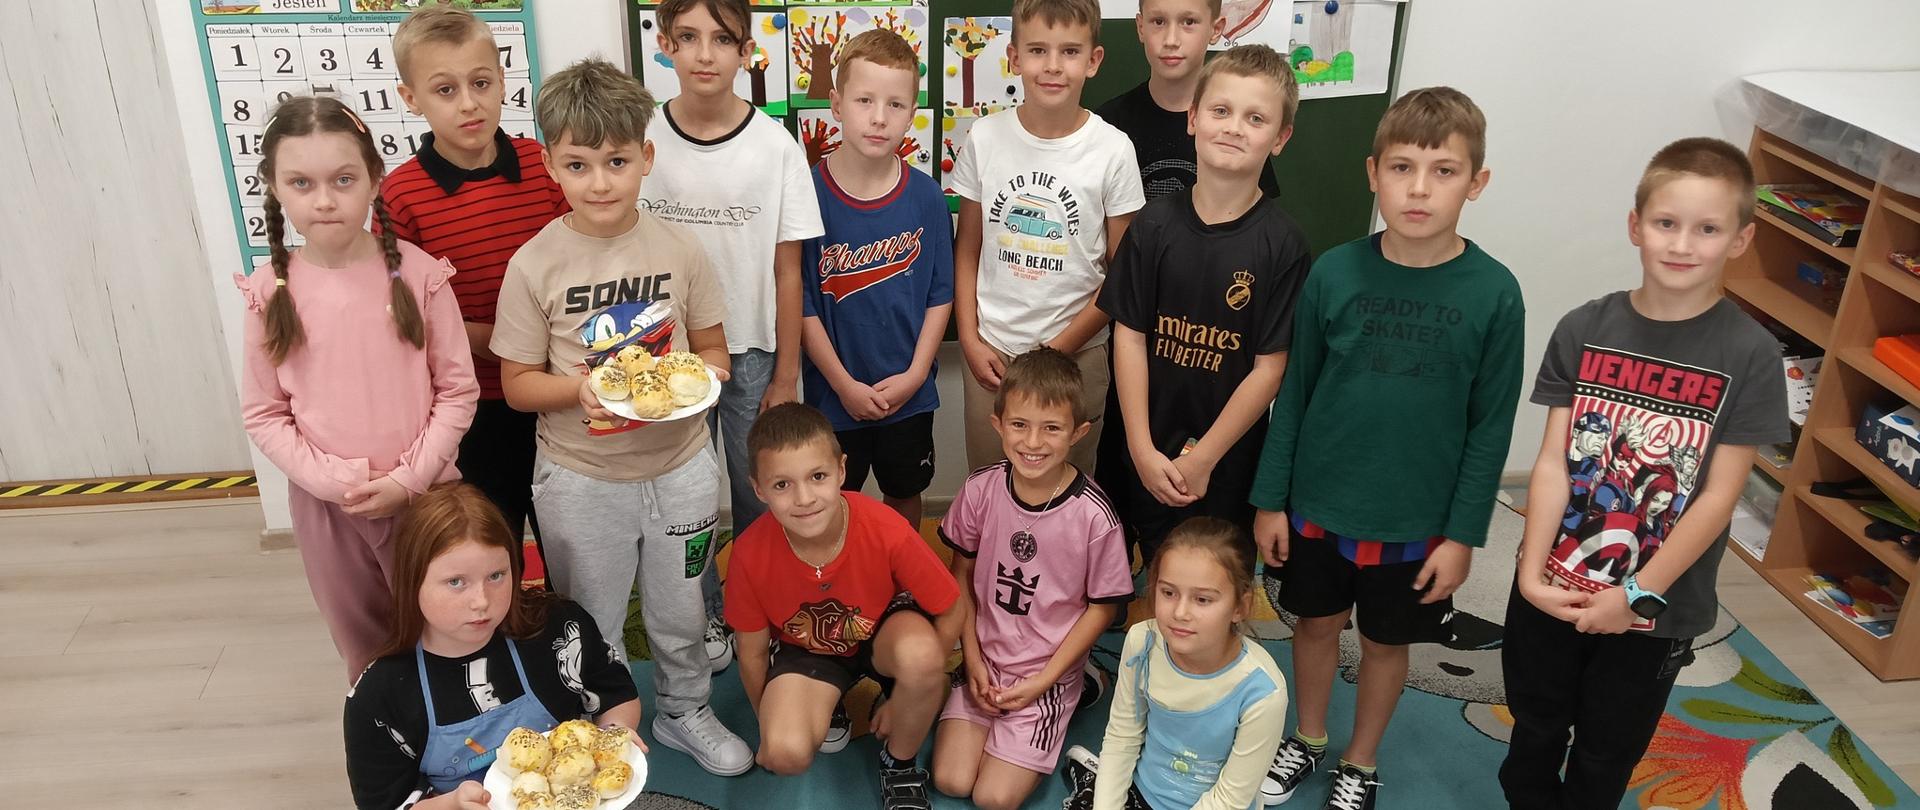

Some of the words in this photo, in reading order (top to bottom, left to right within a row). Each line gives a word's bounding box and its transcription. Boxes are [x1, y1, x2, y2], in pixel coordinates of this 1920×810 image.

[209, 27, 250, 35] Poniedziałek
[261, 26, 290, 34] Wtorek
[309, 25, 333, 33] Środa
[230, 44, 248, 68] 1
[273, 47, 294, 74] 2
[319, 48, 338, 71] 3
[366, 47, 384, 70] 4
[498, 45, 513, 68] 7
[233, 99, 251, 122] 8
[359, 88, 393, 112] 11
[380, 133, 399, 156] 8
[638, 198, 720, 219] Washington
[723, 205, 762, 221] DC
[988, 190, 1008, 224] TAKE
[1008, 174, 1025, 192] TO
[1032, 171, 1057, 190] THE
[1057, 185, 1080, 236] WAVES
[818, 227, 924, 278] Champs
[998, 248, 1021, 265] LONG
[1025, 254, 1063, 272] BEACH
[564, 272, 672, 315] SONIC
[1355, 296, 1430, 320] READY
[1434, 304, 1463, 326] TO
[1154, 315, 1242, 350] mirates
[1360, 318, 1445, 346] SKATE?
[1577, 349, 1725, 410] VENGERS
